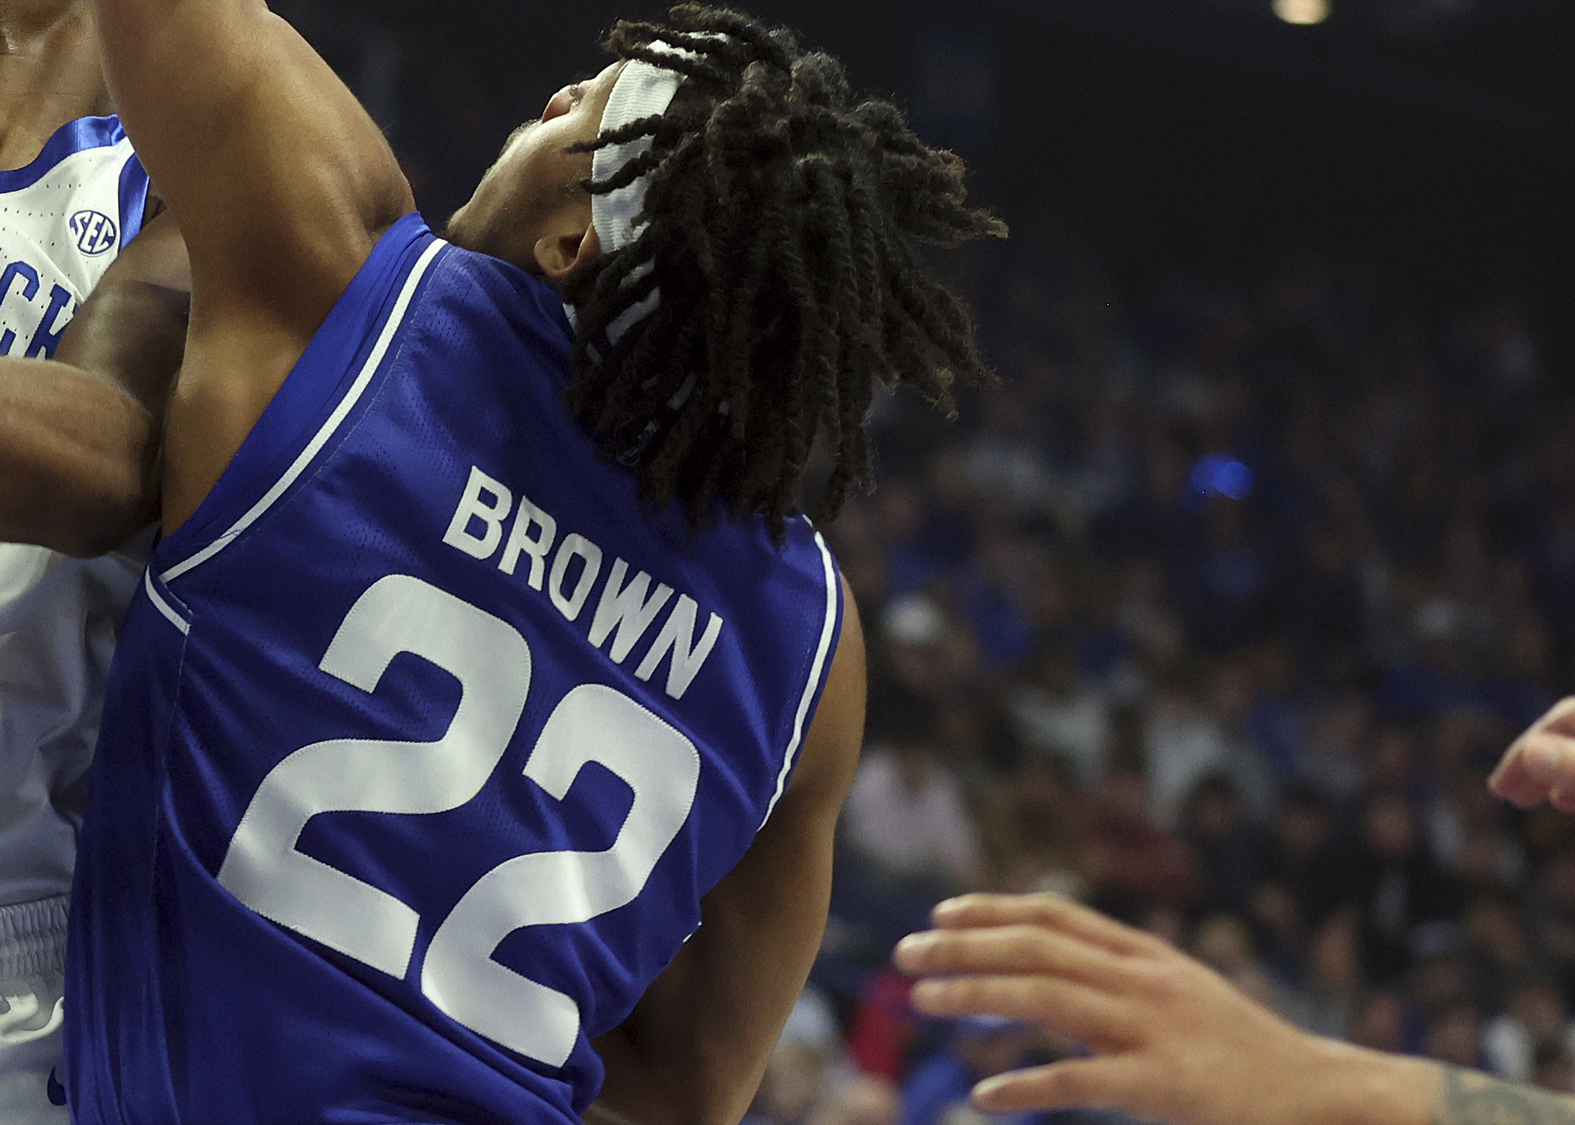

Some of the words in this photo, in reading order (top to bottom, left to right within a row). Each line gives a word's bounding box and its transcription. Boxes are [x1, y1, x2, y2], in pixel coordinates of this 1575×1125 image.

[70, 210, 116, 253] SEC
[443, 465, 724, 701] BROWN
[217, 574, 701, 1068] 22
